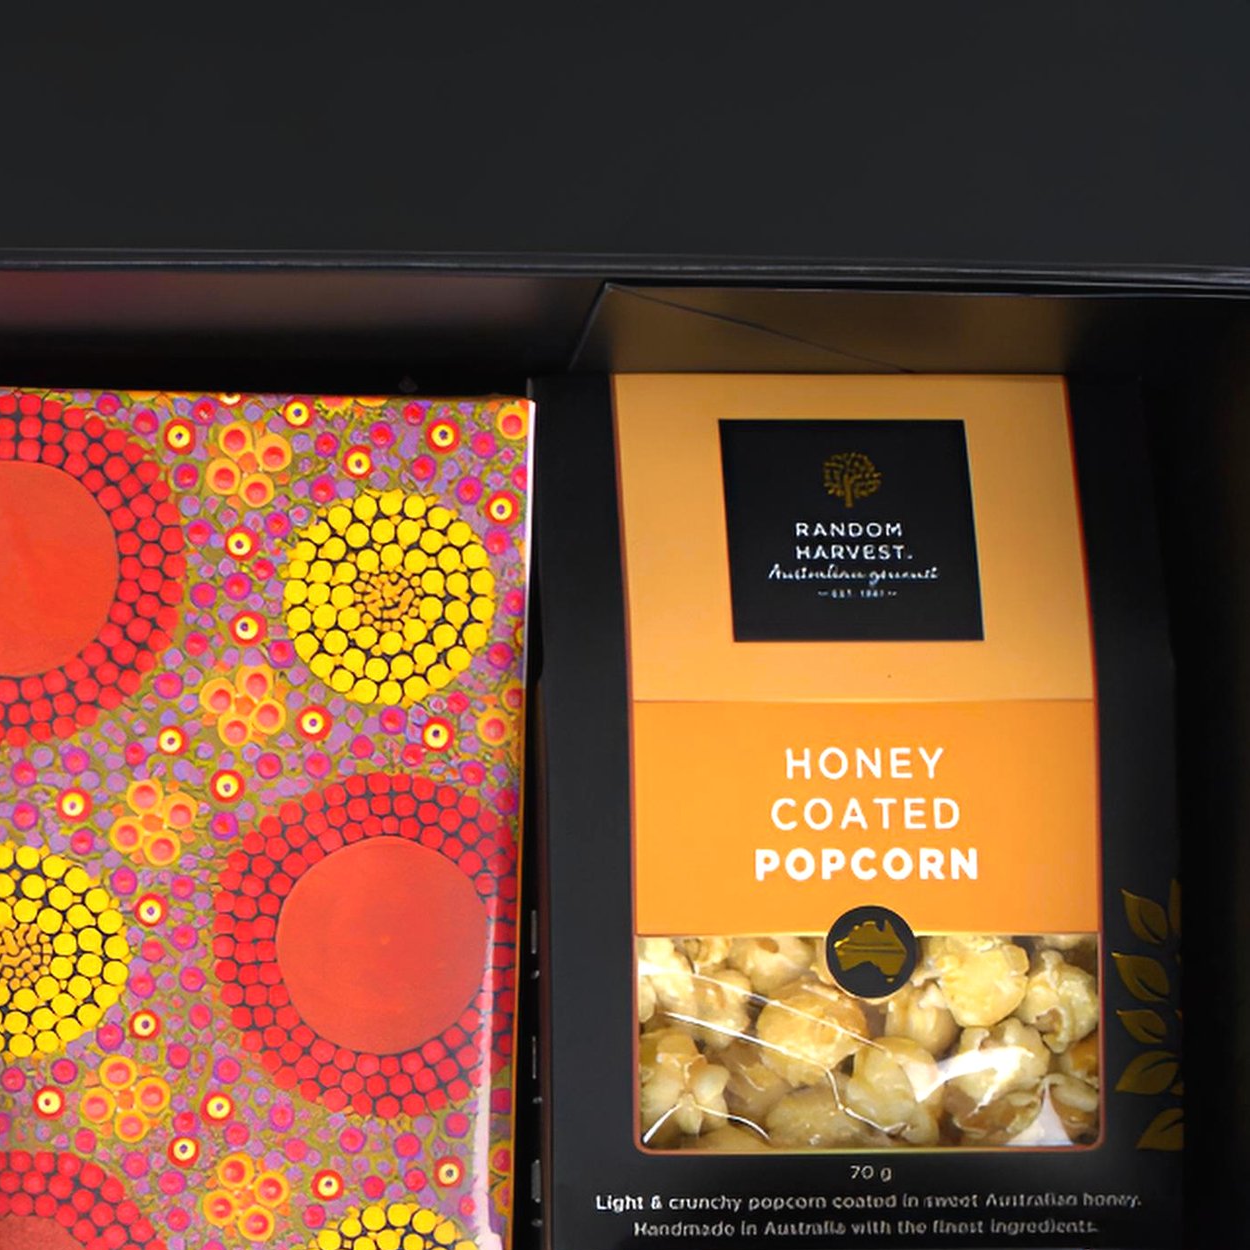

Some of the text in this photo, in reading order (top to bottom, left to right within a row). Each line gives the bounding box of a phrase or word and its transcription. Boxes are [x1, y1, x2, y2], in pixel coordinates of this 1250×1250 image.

[795, 522, 903, 537] RANDOM
[785, 747, 944, 780] HONEY
[771, 797, 960, 831] COATED
[754, 847, 978, 881] POPCORN
[850, 1165, 892, 1182] 70 g
[595, 1192, 1142, 1213] Light & crunchy popcorn coated in sweet Australian honey.
[634, 1221, 735, 1236] Handmade
[741, 1221, 758, 1236] in
[764, 1221, 846, 1236] Australia
[851, 1219, 891, 1235] with
[897, 1220, 927, 1235] the
[933, 1219, 984, 1235] finest
